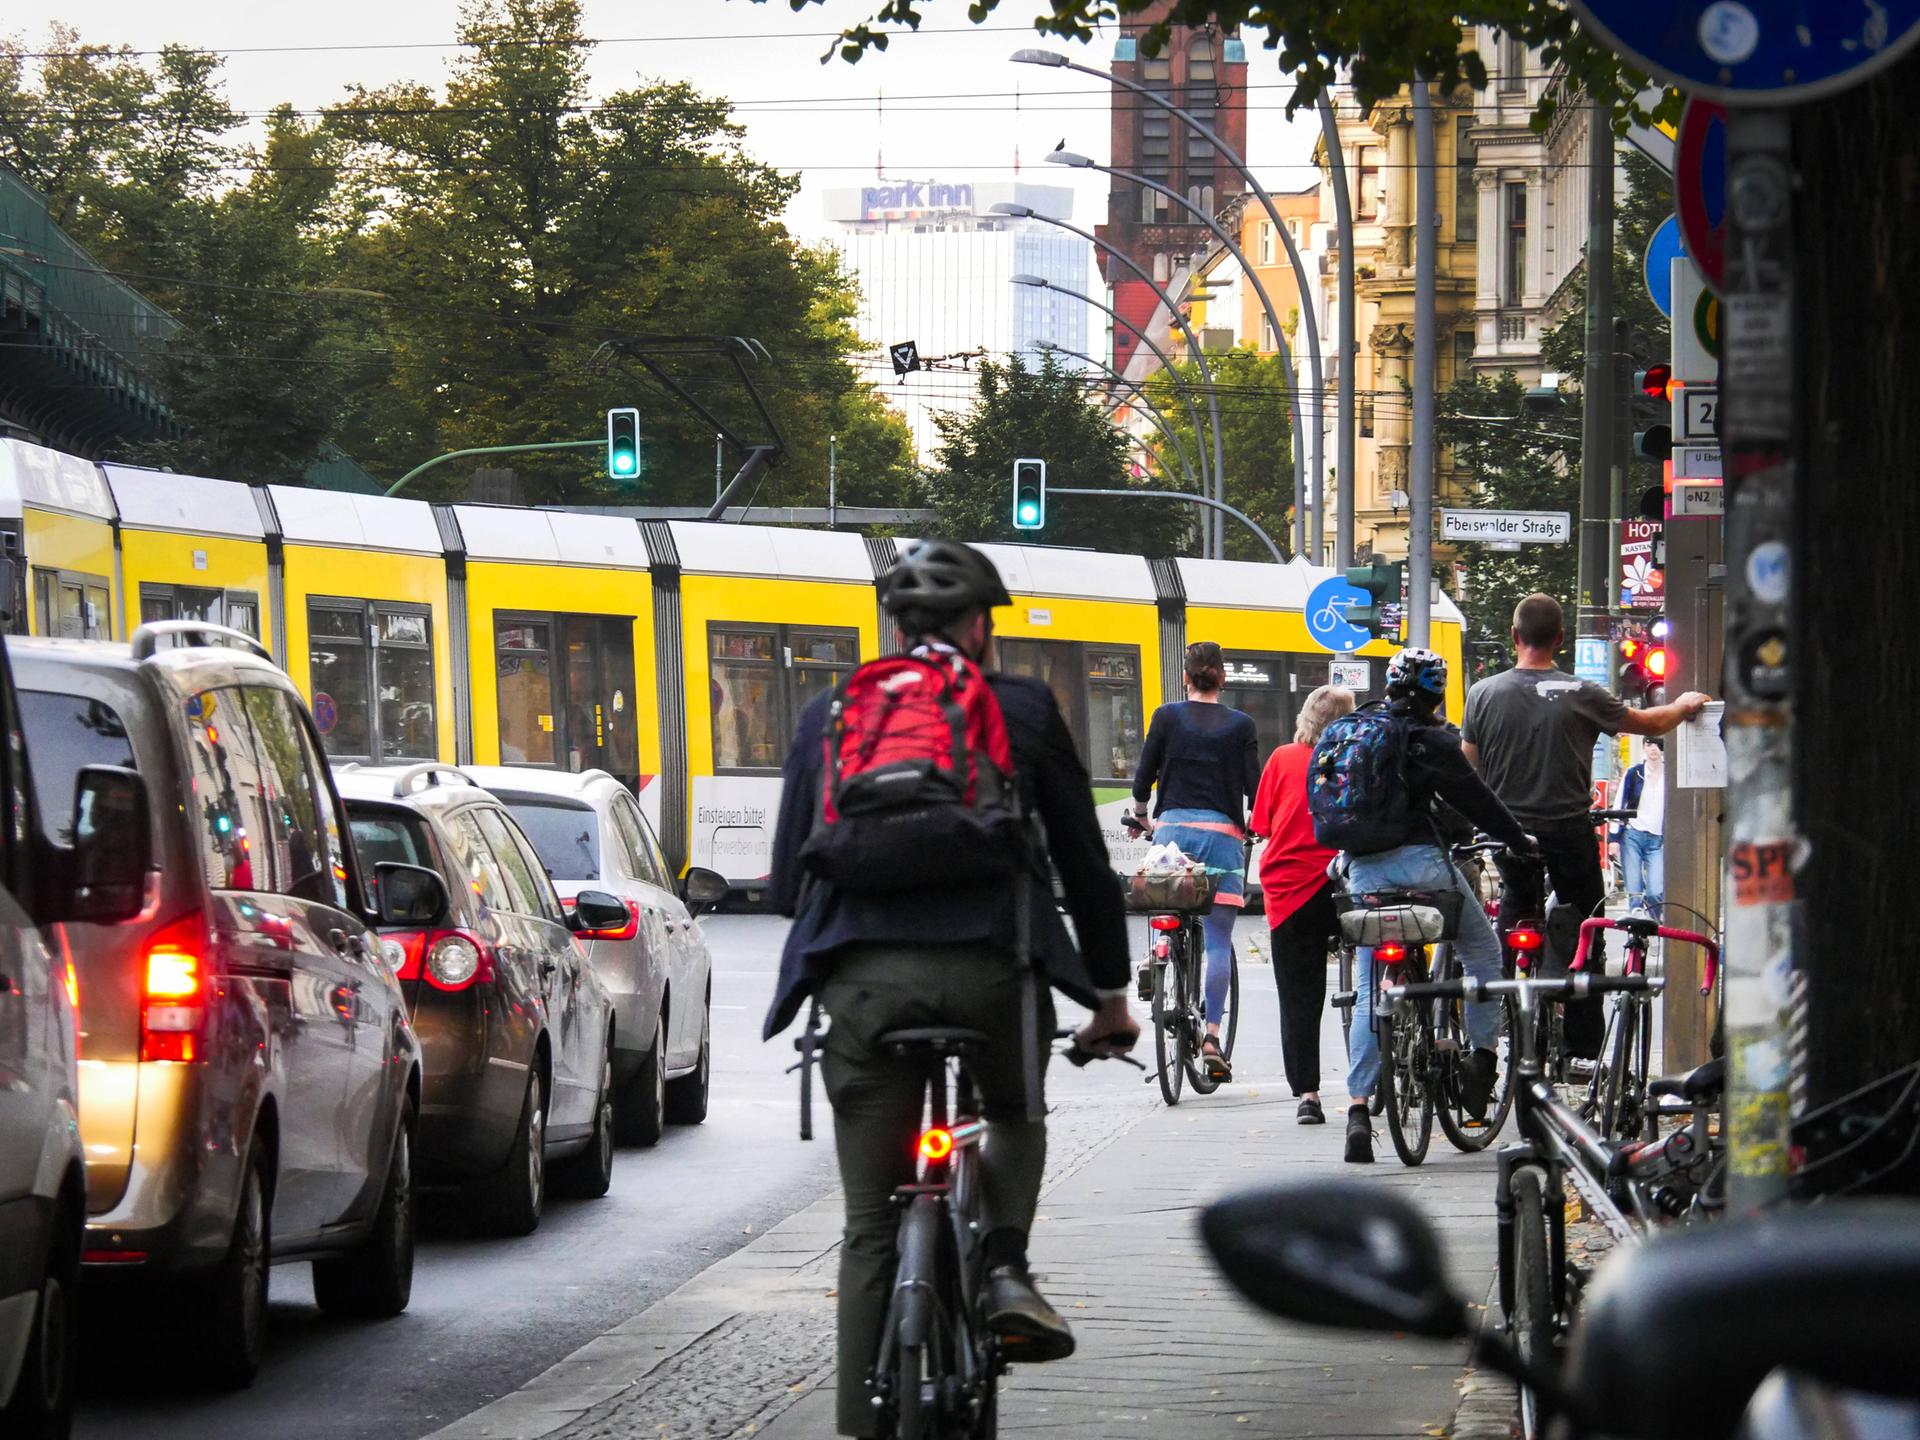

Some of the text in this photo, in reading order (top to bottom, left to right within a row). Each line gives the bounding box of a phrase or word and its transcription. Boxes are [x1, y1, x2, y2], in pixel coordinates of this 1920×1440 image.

[861, 180, 971, 222] park inn
[1695, 491, 1710, 502] N2
[1522, 519, 1561, 537] Straße
[698, 805, 766, 827] Einsteigen bitte!
